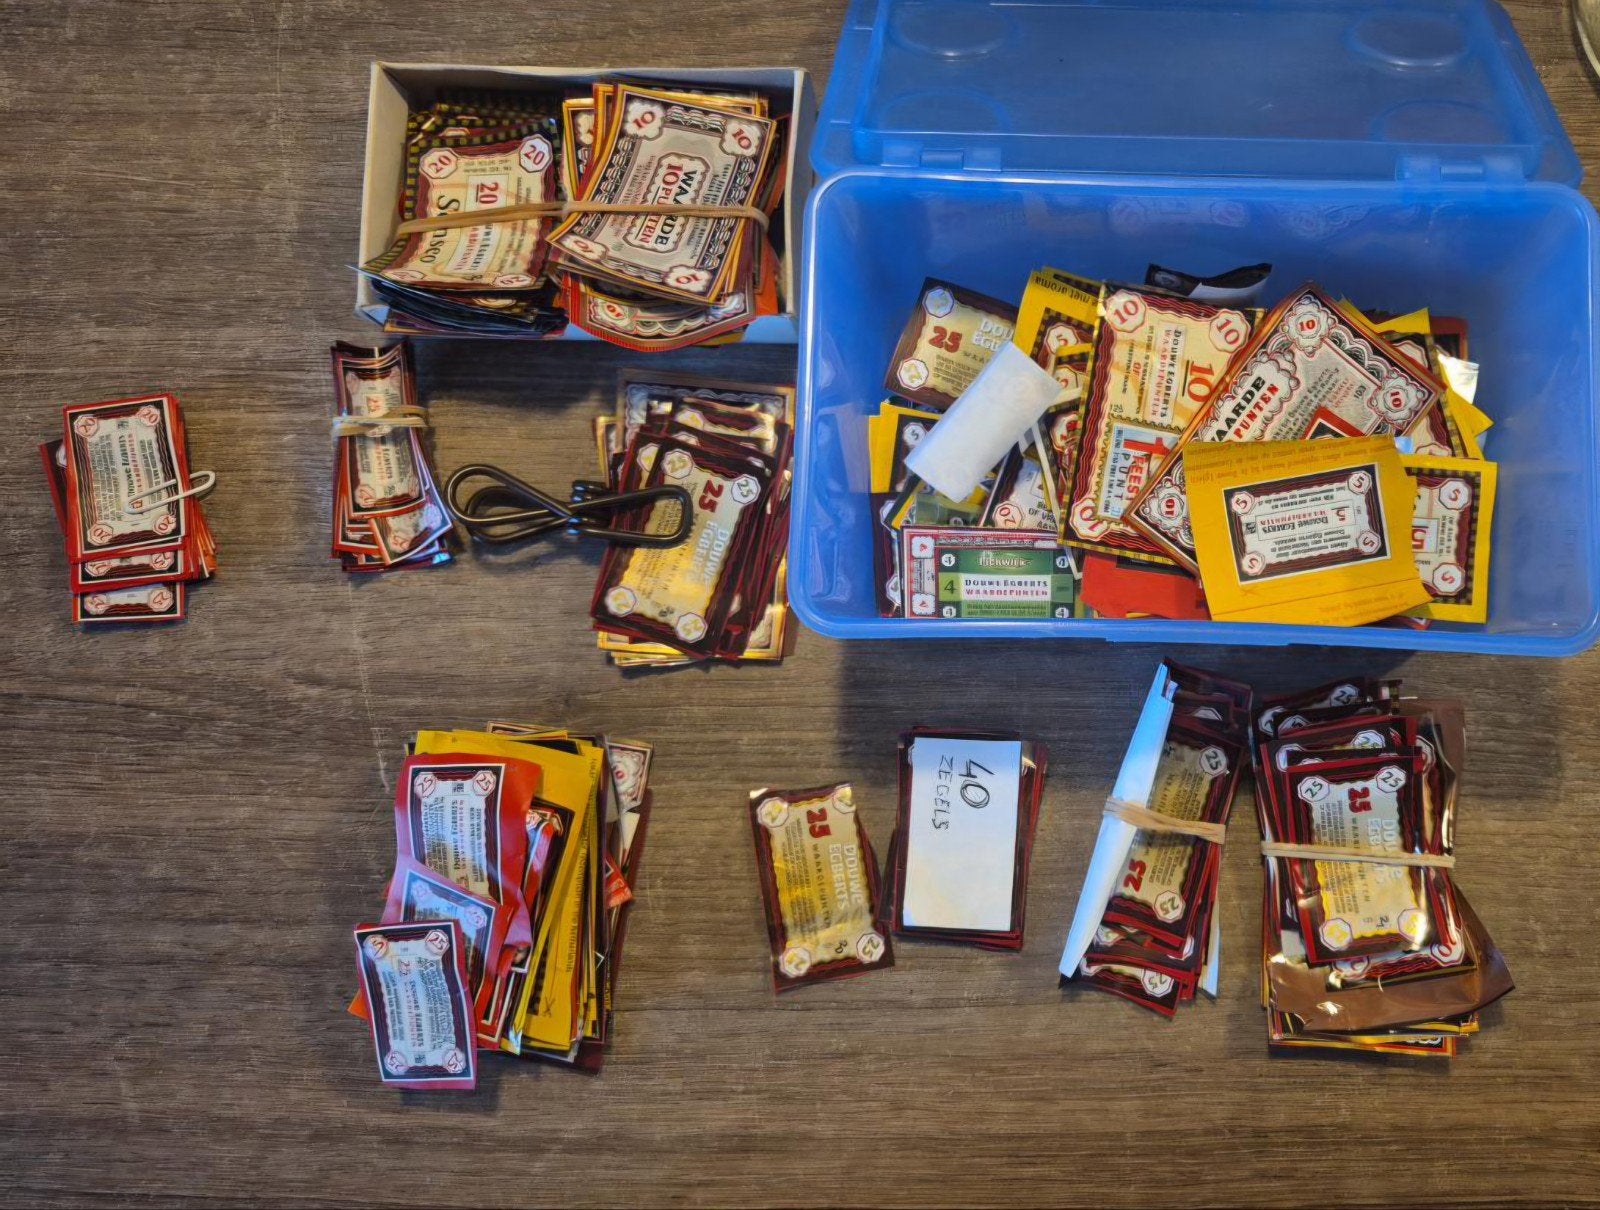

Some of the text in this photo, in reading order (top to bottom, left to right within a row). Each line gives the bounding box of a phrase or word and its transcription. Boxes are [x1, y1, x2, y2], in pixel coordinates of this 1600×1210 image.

[633, 111, 656, 128] 10
[732, 128, 752, 150] 10
[429, 155, 451, 172] 20
[524, 144, 545, 165] 20
[479, 182, 498, 205] 20
[638, 163, 684, 244] 10 PUTEN
[675, 274, 702, 286] 10
[1035, 275, 1068, 298] aroma
[605, 303, 624, 319] 10
[1114, 300, 1140, 325] 10
[981, 318, 1015, 340] DOU
[1216, 318, 1241, 346] 10
[1299, 319, 1318, 331] 10
[928, 325, 963, 354] 25
[1160, 329, 1183, 419] DOUWE EGBERTS
[1187, 360, 1216, 403] 10
[1211, 376, 1266, 442] AARDE
[1390, 390, 1401, 409] 10
[142, 410, 158, 424] 20
[1233, 384, 1280, 440] PUNTEN
[82, 418, 97, 434] 20
[911, 429, 920, 441] 5
[1123, 437, 1172, 457] 1
[1113, 452, 1131, 502] PUNT
[1354, 477, 1364, 488] 5
[699, 480, 724, 513] 25
[736, 479, 752, 498] 25
[1451, 489, 1462, 503] 5
[1164, 498, 1176, 516] 10
[1236, 496, 1248, 508] 5
[999, 506, 1017, 526] 20
[1080, 506, 1104, 532] 10
[1336, 508, 1347, 522] 5
[93, 528, 112, 540] 20
[158, 518, 170, 532] 20
[1362, 536, 1374, 548] 5
[1411, 528, 1428, 551] 5
[945, 556, 953, 566] 4
[1248, 558, 1258, 569] 5
[944, 579, 1048, 595] 4 DOUWE EGBERTS
[1441, 571, 1455, 584] 5
[965, 588, 1048, 596] WAARDEPUNTEN
[1204, 750, 1222, 771] 25
[418, 777, 434, 793] 25
[476, 774, 492, 791] 25
[958, 758, 995, 809] 40
[1380, 771, 1402, 788] 25
[931, 754, 954, 830] ZEGELS
[1305, 781, 1324, 798] 25
[1348, 786, 1372, 814] 25
[806, 807, 832, 839] 25
[829, 844, 850, 910] EGBERTS
[844, 844, 864, 904] DOUWE
[1124, 858, 1147, 892] 25
[1158, 897, 1180, 915] 25
[428, 934, 445, 950] 25
[862, 936, 880, 958] 25
[400, 960, 411, 977] 25
